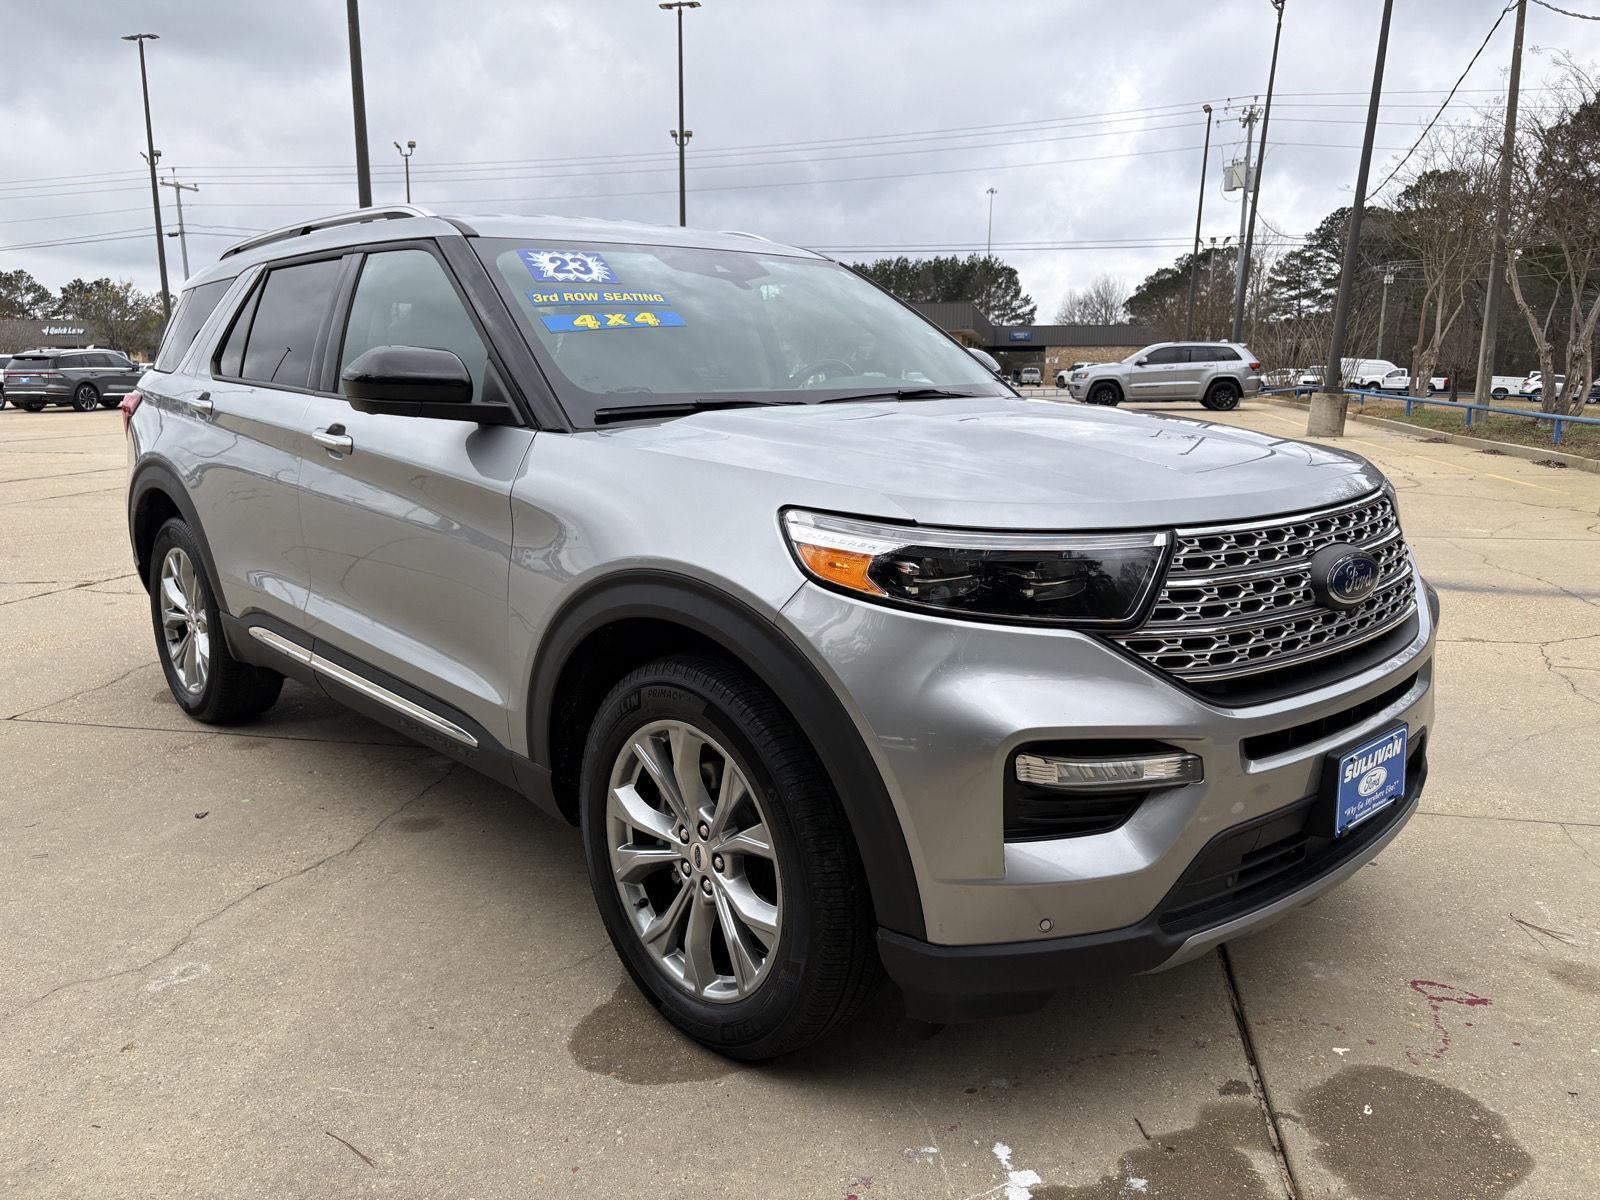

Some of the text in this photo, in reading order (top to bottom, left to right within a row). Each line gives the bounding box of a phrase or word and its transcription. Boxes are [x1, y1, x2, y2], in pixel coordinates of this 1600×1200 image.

[549, 256, 594, 276] 23
[532, 292, 665, 303] 3rd ROW SEATING
[49, 326, 67, 335] Quick
[1345, 564, 1373, 594] Ford
[1343, 737, 1403, 784] SULLIVAN
[1363, 772, 1380, 793] Ford
